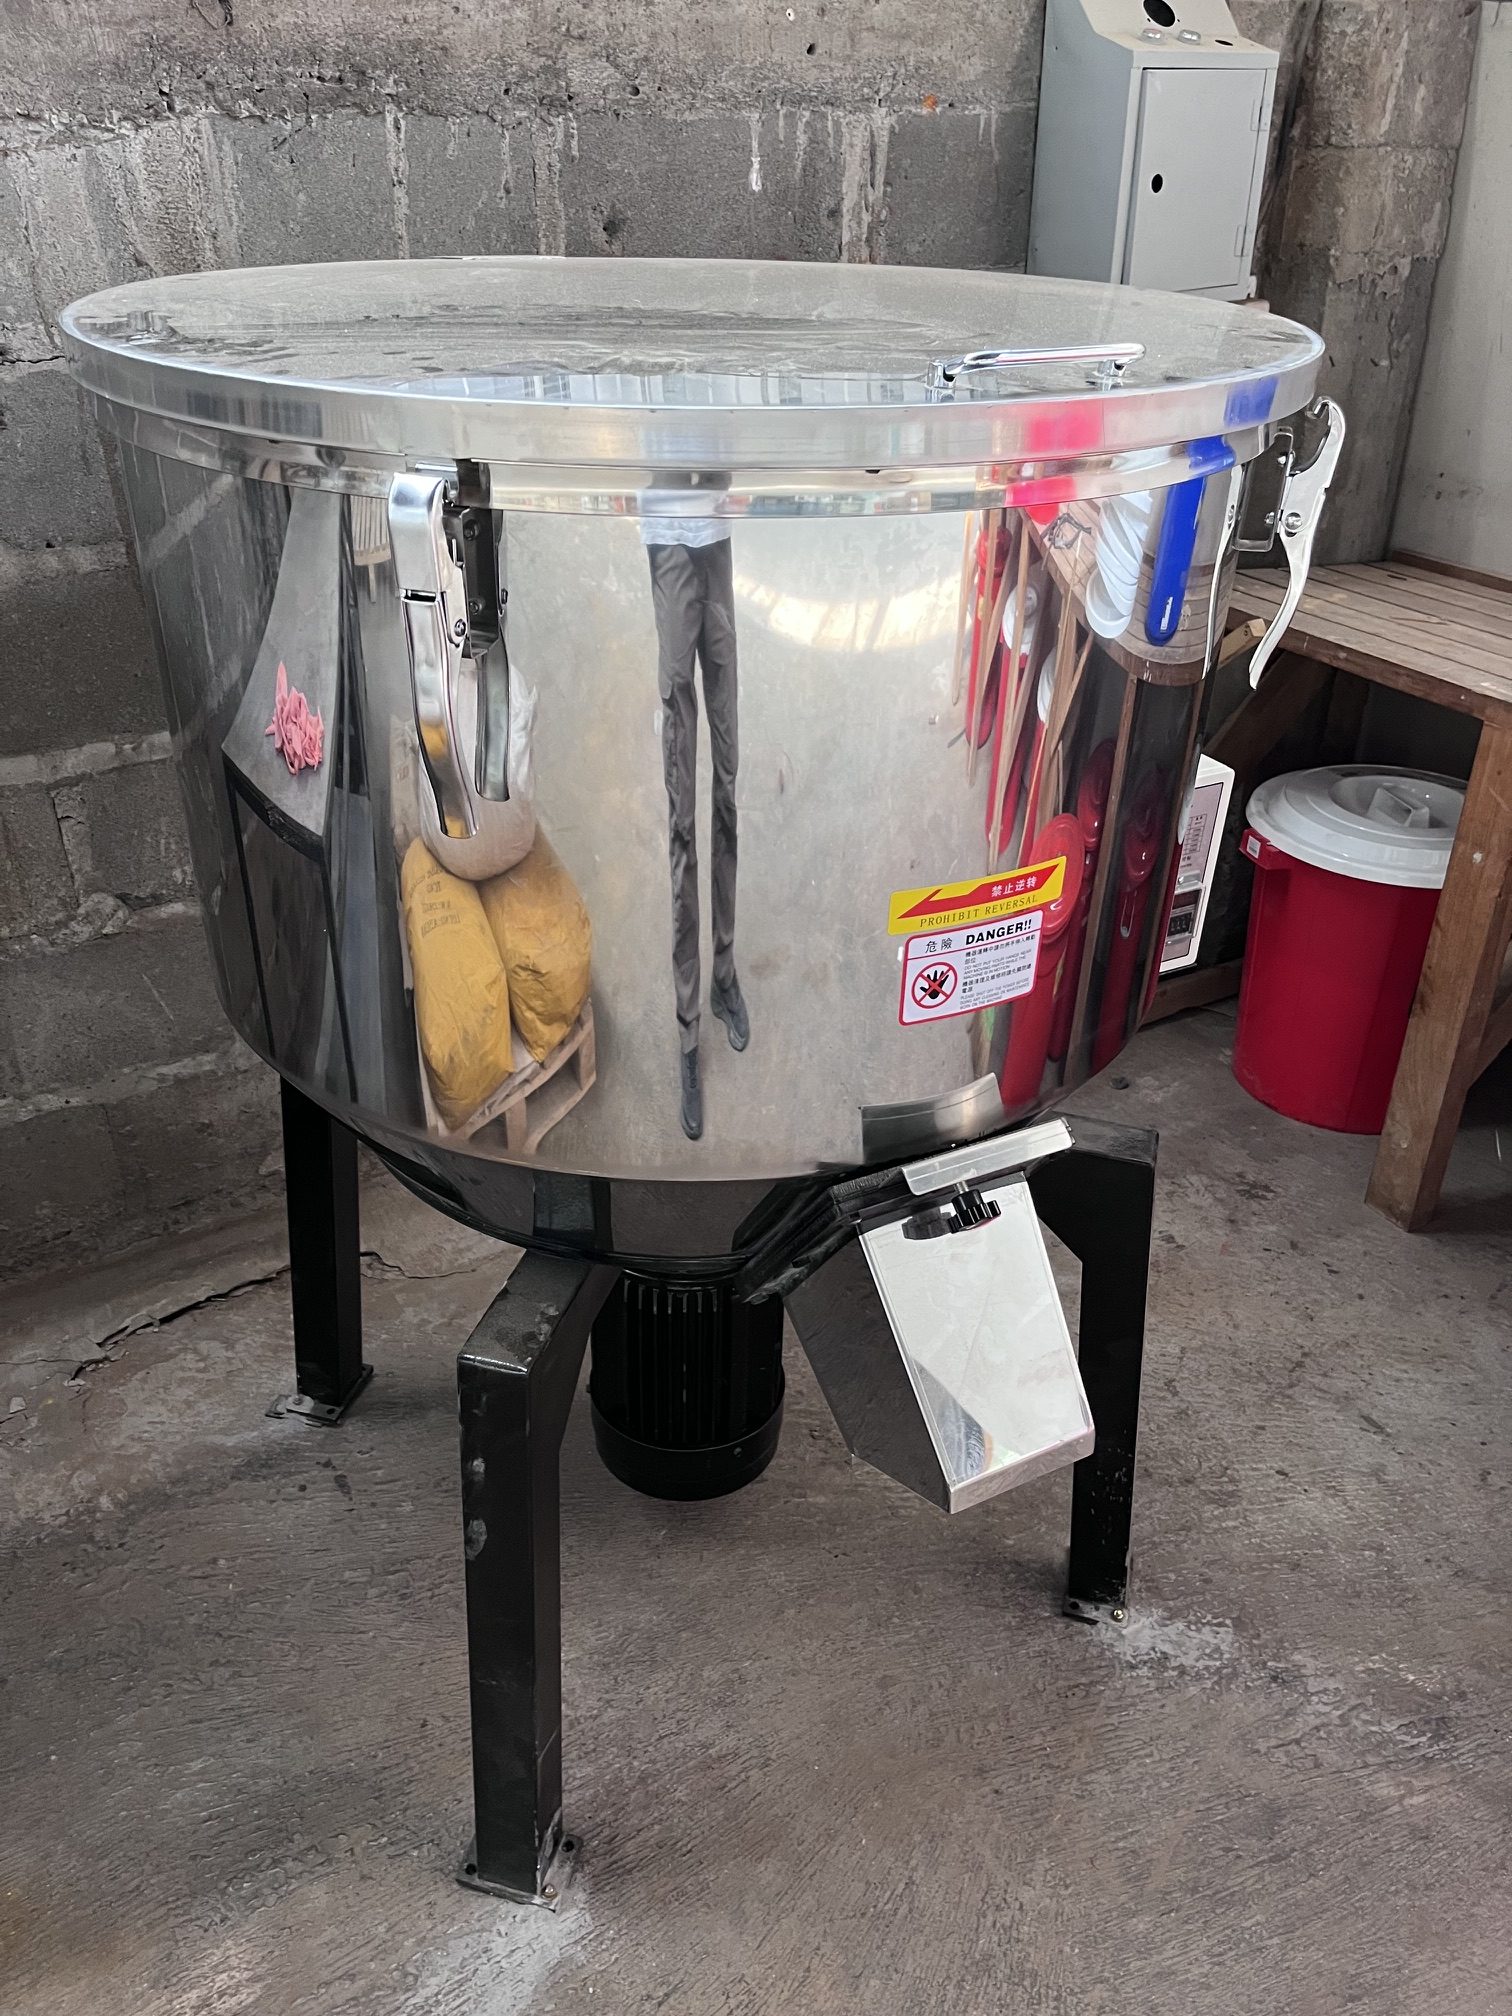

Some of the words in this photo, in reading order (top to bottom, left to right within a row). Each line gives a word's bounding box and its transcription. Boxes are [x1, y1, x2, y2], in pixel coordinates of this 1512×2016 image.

[991, 876, 1037, 897] 禁止逆转
[920, 908, 980, 927] PROHIBIT
[984, 894, 1038, 915] REVERSAL
[965, 919, 1032, 946] DANGER!!
[925, 937, 953, 954] 危險
